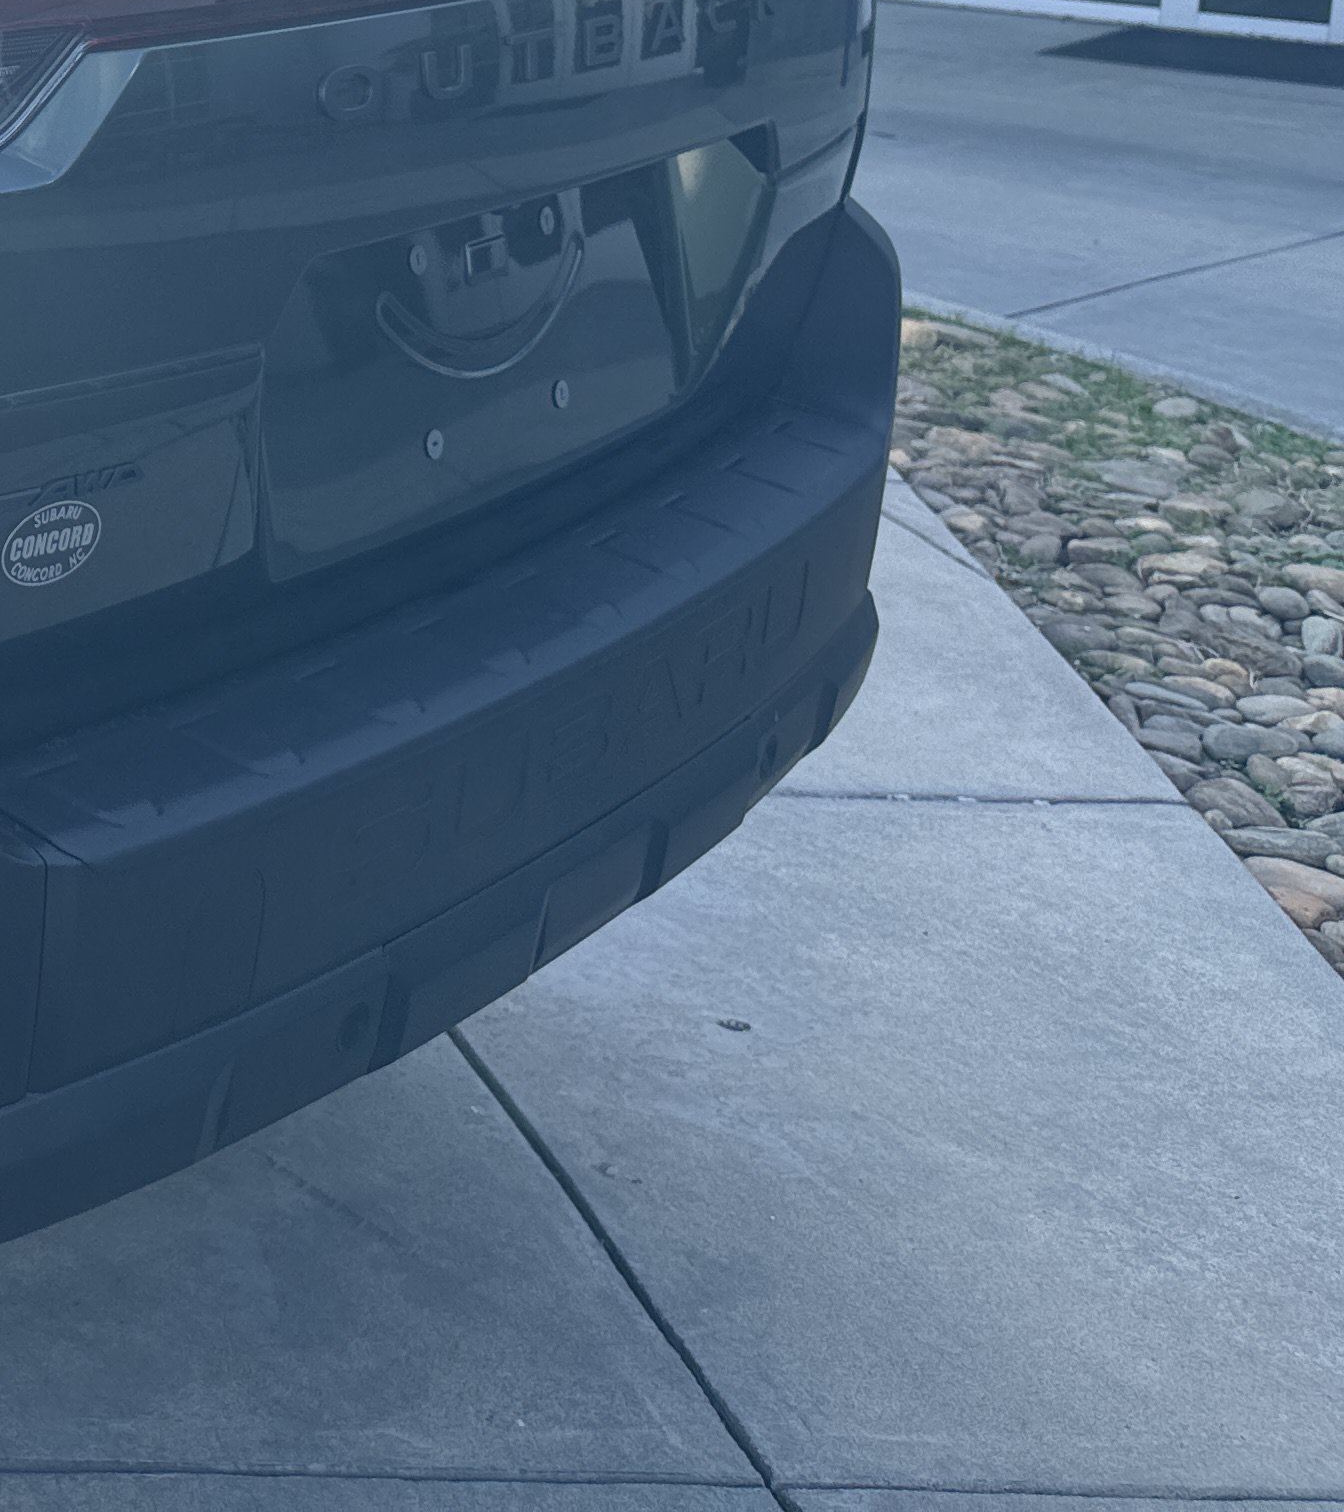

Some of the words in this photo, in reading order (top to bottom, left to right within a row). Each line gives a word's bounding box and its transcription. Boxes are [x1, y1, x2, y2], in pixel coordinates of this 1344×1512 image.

[33, 504, 83, 529] SUBARU
[9, 522, 95, 563] CONCORD
[10, 562, 63, 583] CONCORD
[68, 547, 87, 569] NC
